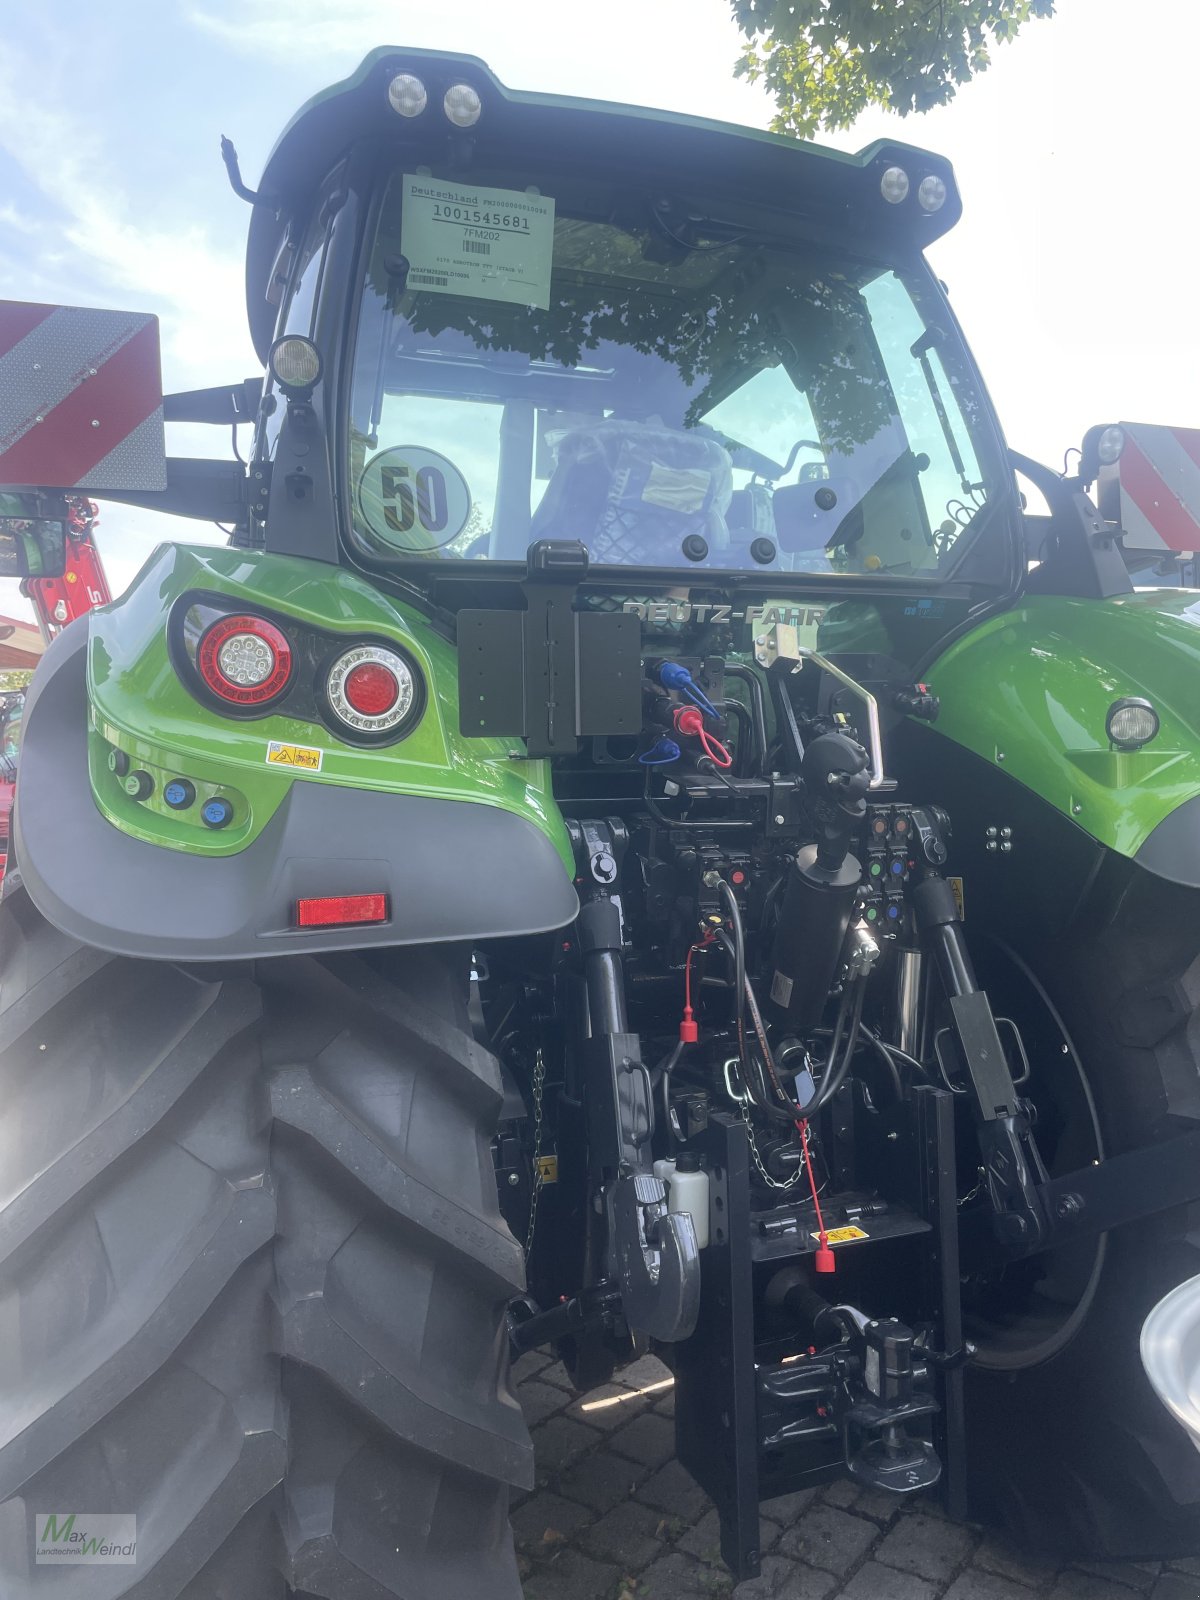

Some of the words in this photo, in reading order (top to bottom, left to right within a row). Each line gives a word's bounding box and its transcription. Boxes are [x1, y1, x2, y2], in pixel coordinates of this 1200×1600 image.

[411, 186, 479, 204] Deutschland
[433, 204, 530, 229] 1001545681
[463, 228, 500, 241] 7FM202
[381, 466, 449, 532] 50
[623, 602, 826, 626] DEUTZ-FAHR
